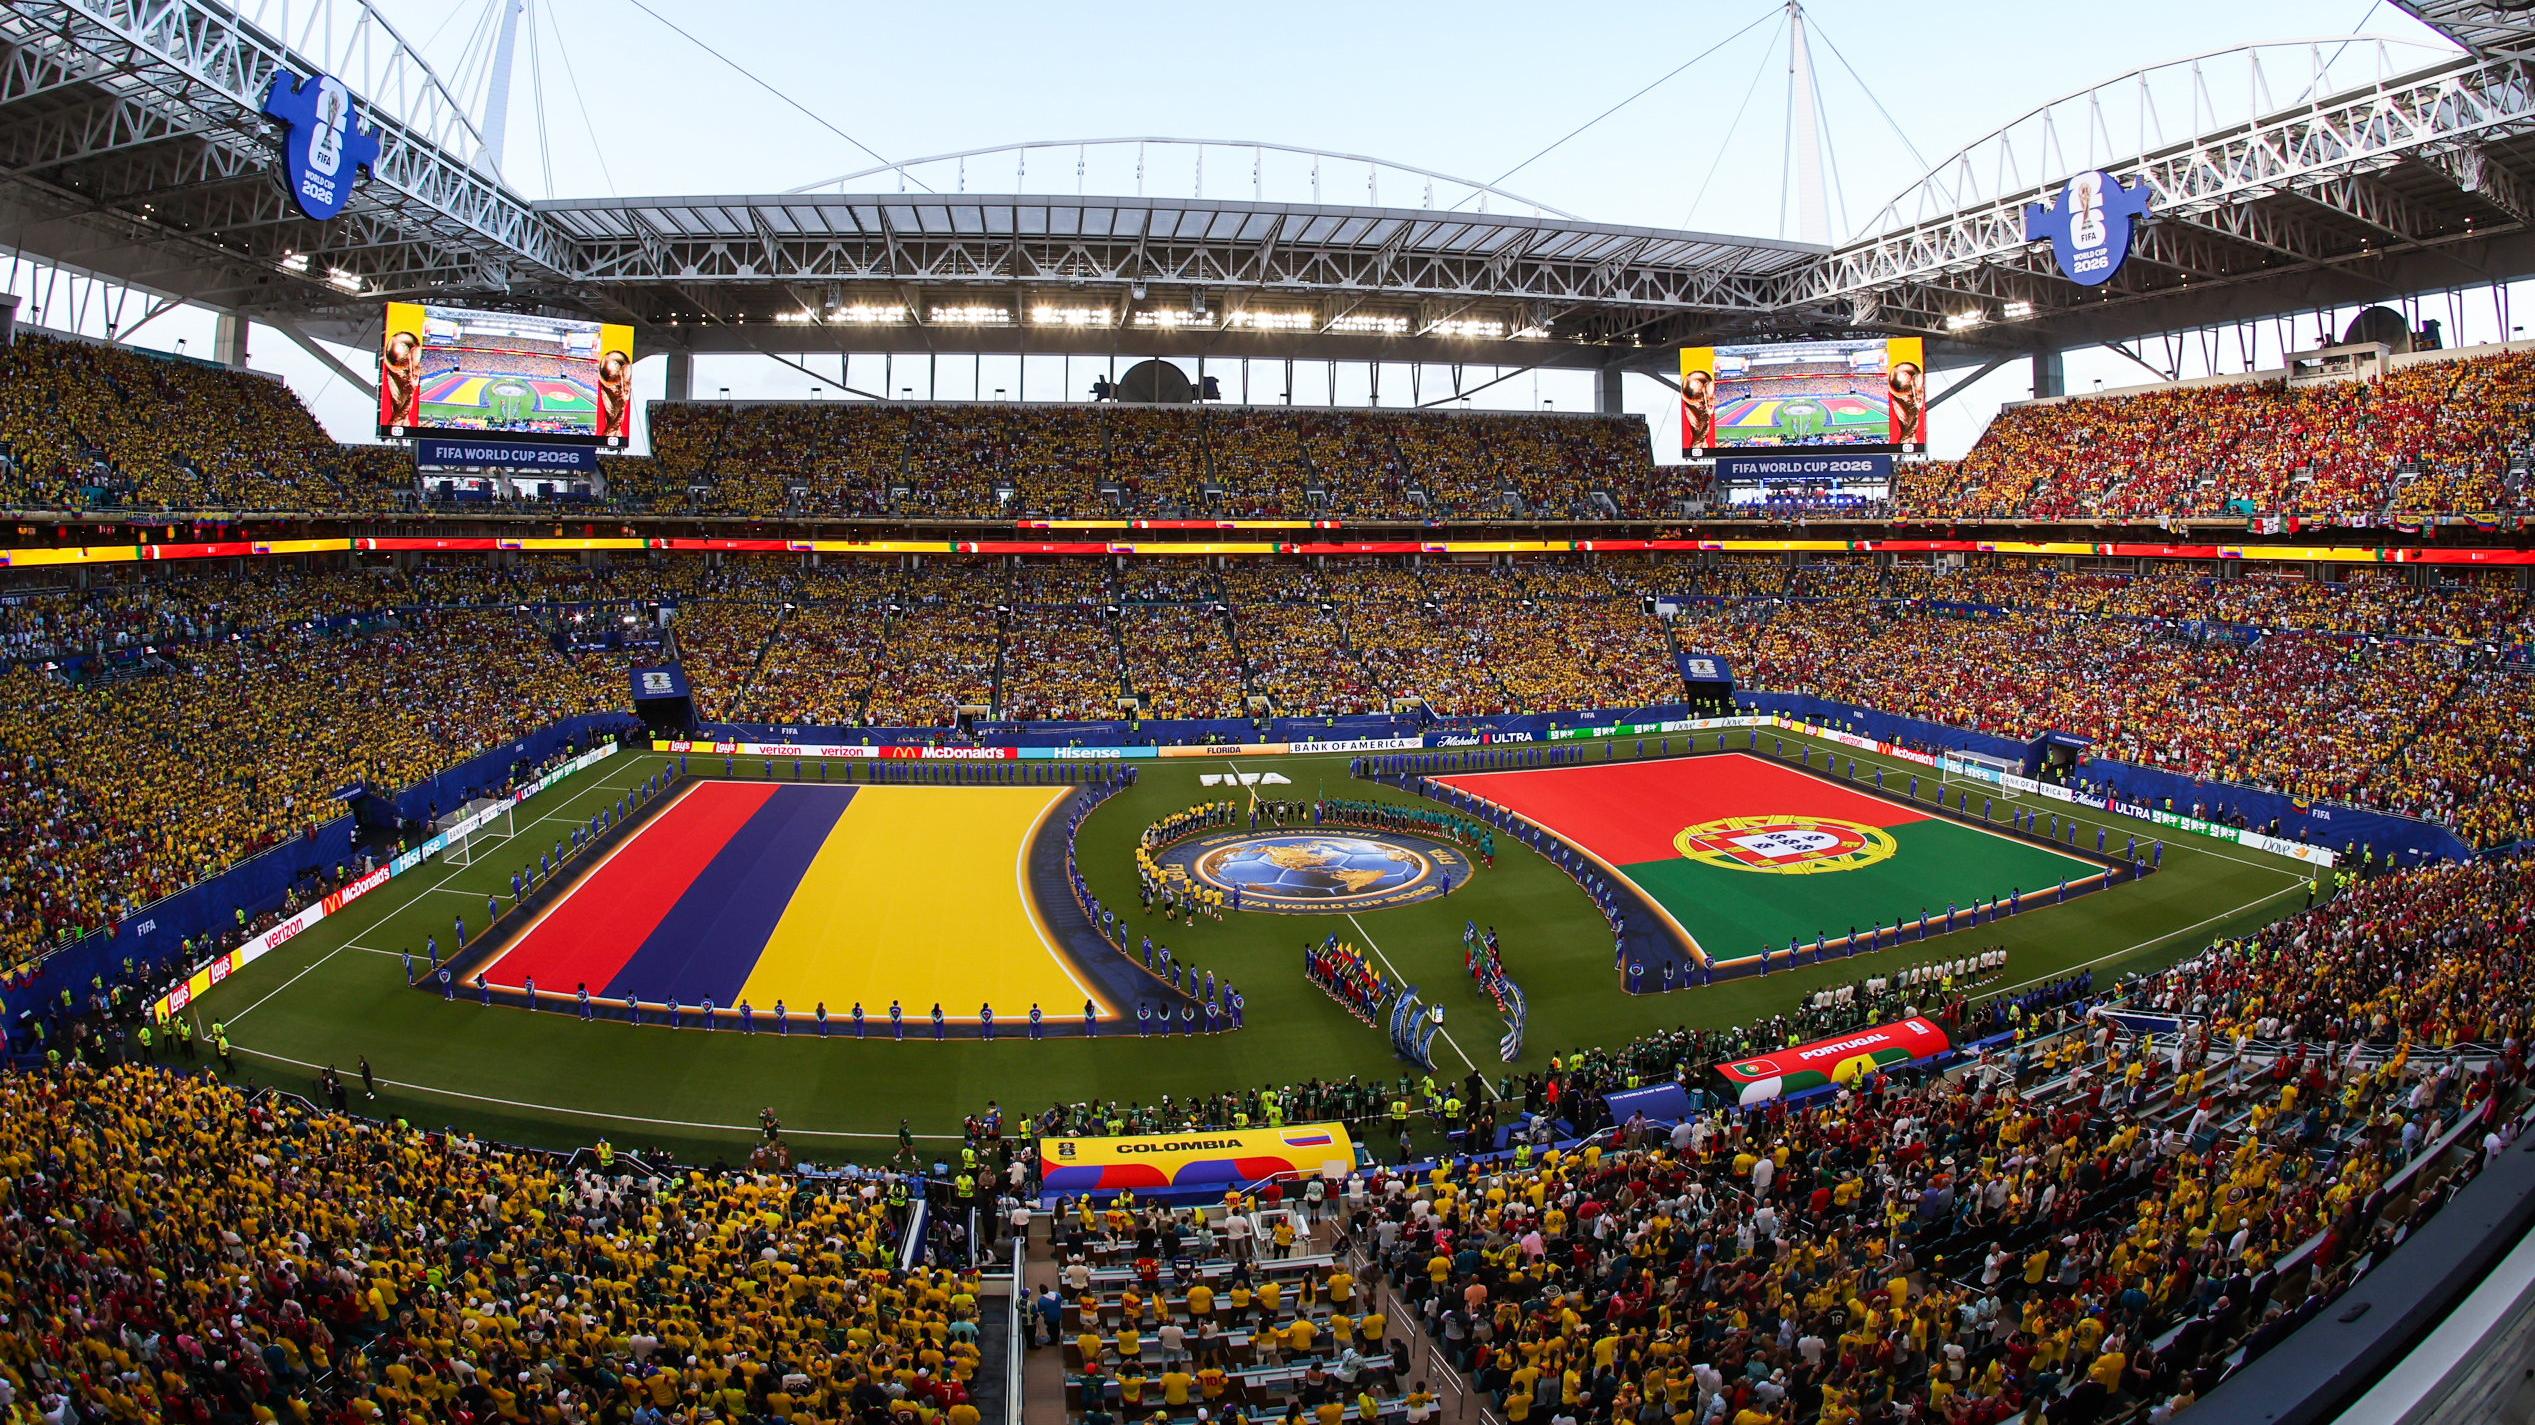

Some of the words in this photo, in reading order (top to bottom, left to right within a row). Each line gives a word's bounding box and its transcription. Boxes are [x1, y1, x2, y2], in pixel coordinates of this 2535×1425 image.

[317, 152, 331, 167] FIFA
[305, 170, 324, 186] WORLD
[324, 178, 336, 191] CUP
[301, 180, 334, 206] 2026
[2081, 233, 2096, 242] FIFA
[2072, 250, 2096, 261] WORLD
[2095, 248, 2108, 256] CUP
[2074, 256, 2109, 274] 2026
[436, 447, 462, 459] FIFA
[464, 448, 510, 461] WORLD
[512, 450, 536, 462] CUP
[537, 451, 580, 464] 2026
[1732, 462, 1757, 474] FIFA
[1760, 461, 1802, 473] WORLD
[1803, 461, 1828, 472] CUP
[1830, 461, 1872, 472] 2026
[1672, 721, 1696, 731] Dove
[1721, 716, 1744, 728] Dove
[781, 727, 798, 735] FIFA
[1294, 742, 1328, 752] BANK
[1332, 741, 1349, 751] OF
[1350, 739, 1405, 750] AMERICA
[1436, 735, 1480, 748] Michelob
[1491, 732, 1533, 744] ULTRA
[1838, 734, 1863, 748] verizon
[759, 744, 801, 755] verizon
[820, 745, 864, 757] verizon
[922, 746, 1005, 759] McDonald's
[1054, 747, 1121, 758] Hisense
[1207, 746, 1241, 755] FLORIDA
[1892, 746, 1934, 766] McDonald's
[1945, 762, 1990, 779] Hisense
[1200, 772, 1292, 786] FIFA
[521, 781, 540, 800] ULTRA
[2115, 800, 2151, 820] ULTRA
[2312, 808, 2330, 821] FIFA
[2261, 838, 2290, 854] Dove
[399, 838, 441, 873] Hisense
[341, 867, 390, 904] McDonald's
[1275, 902, 1345, 910] WORLD
[1347, 899, 1383, 908] CUP
[1385, 884, 1437, 903] 2026
[137, 919, 157, 937] FIFA
[265, 917, 304, 949] verizon
[210, 956, 231, 985] Lay's
[169, 984, 189, 1014] Lay's
[1799, 1033, 1890, 1060] PORTUGAL
[1116, 1138, 1243, 1153] COLOMBIA
[756, 1266, 767, 1275] 10
[1141, 1264, 1152, 1273] 10
[1831, 1315, 1843, 1326] 18
[1206, 1377, 1217, 1387] 10
[944, 1388, 951, 1400] 7
